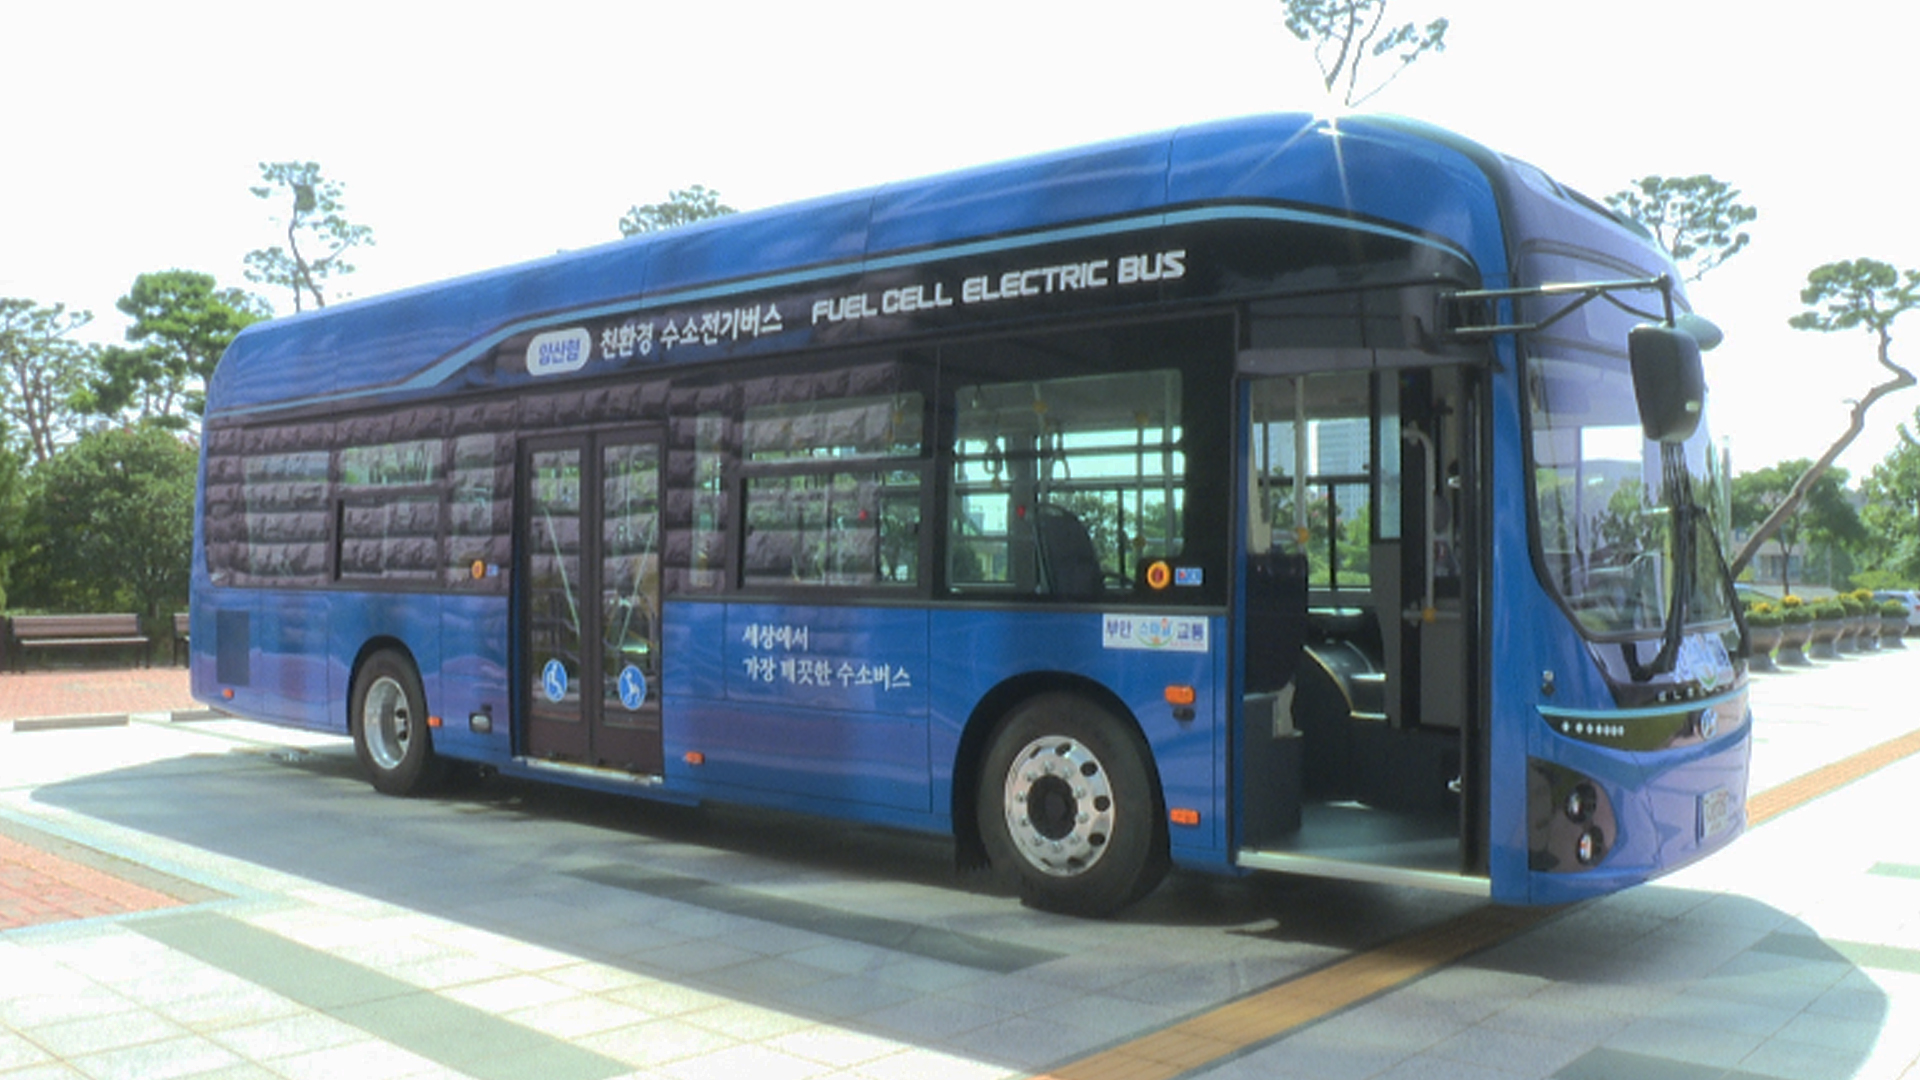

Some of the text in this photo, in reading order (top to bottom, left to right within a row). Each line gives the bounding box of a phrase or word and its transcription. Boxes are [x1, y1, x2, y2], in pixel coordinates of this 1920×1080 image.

[811, 249, 1186, 325] FUEL CELL ELECTRIC BUS
[600, 303, 783, 360] 친환경 수소전기버스
[742, 623, 809, 651] 세상에서
[742, 656, 911, 692] 가장 깨끗한 수소버스
